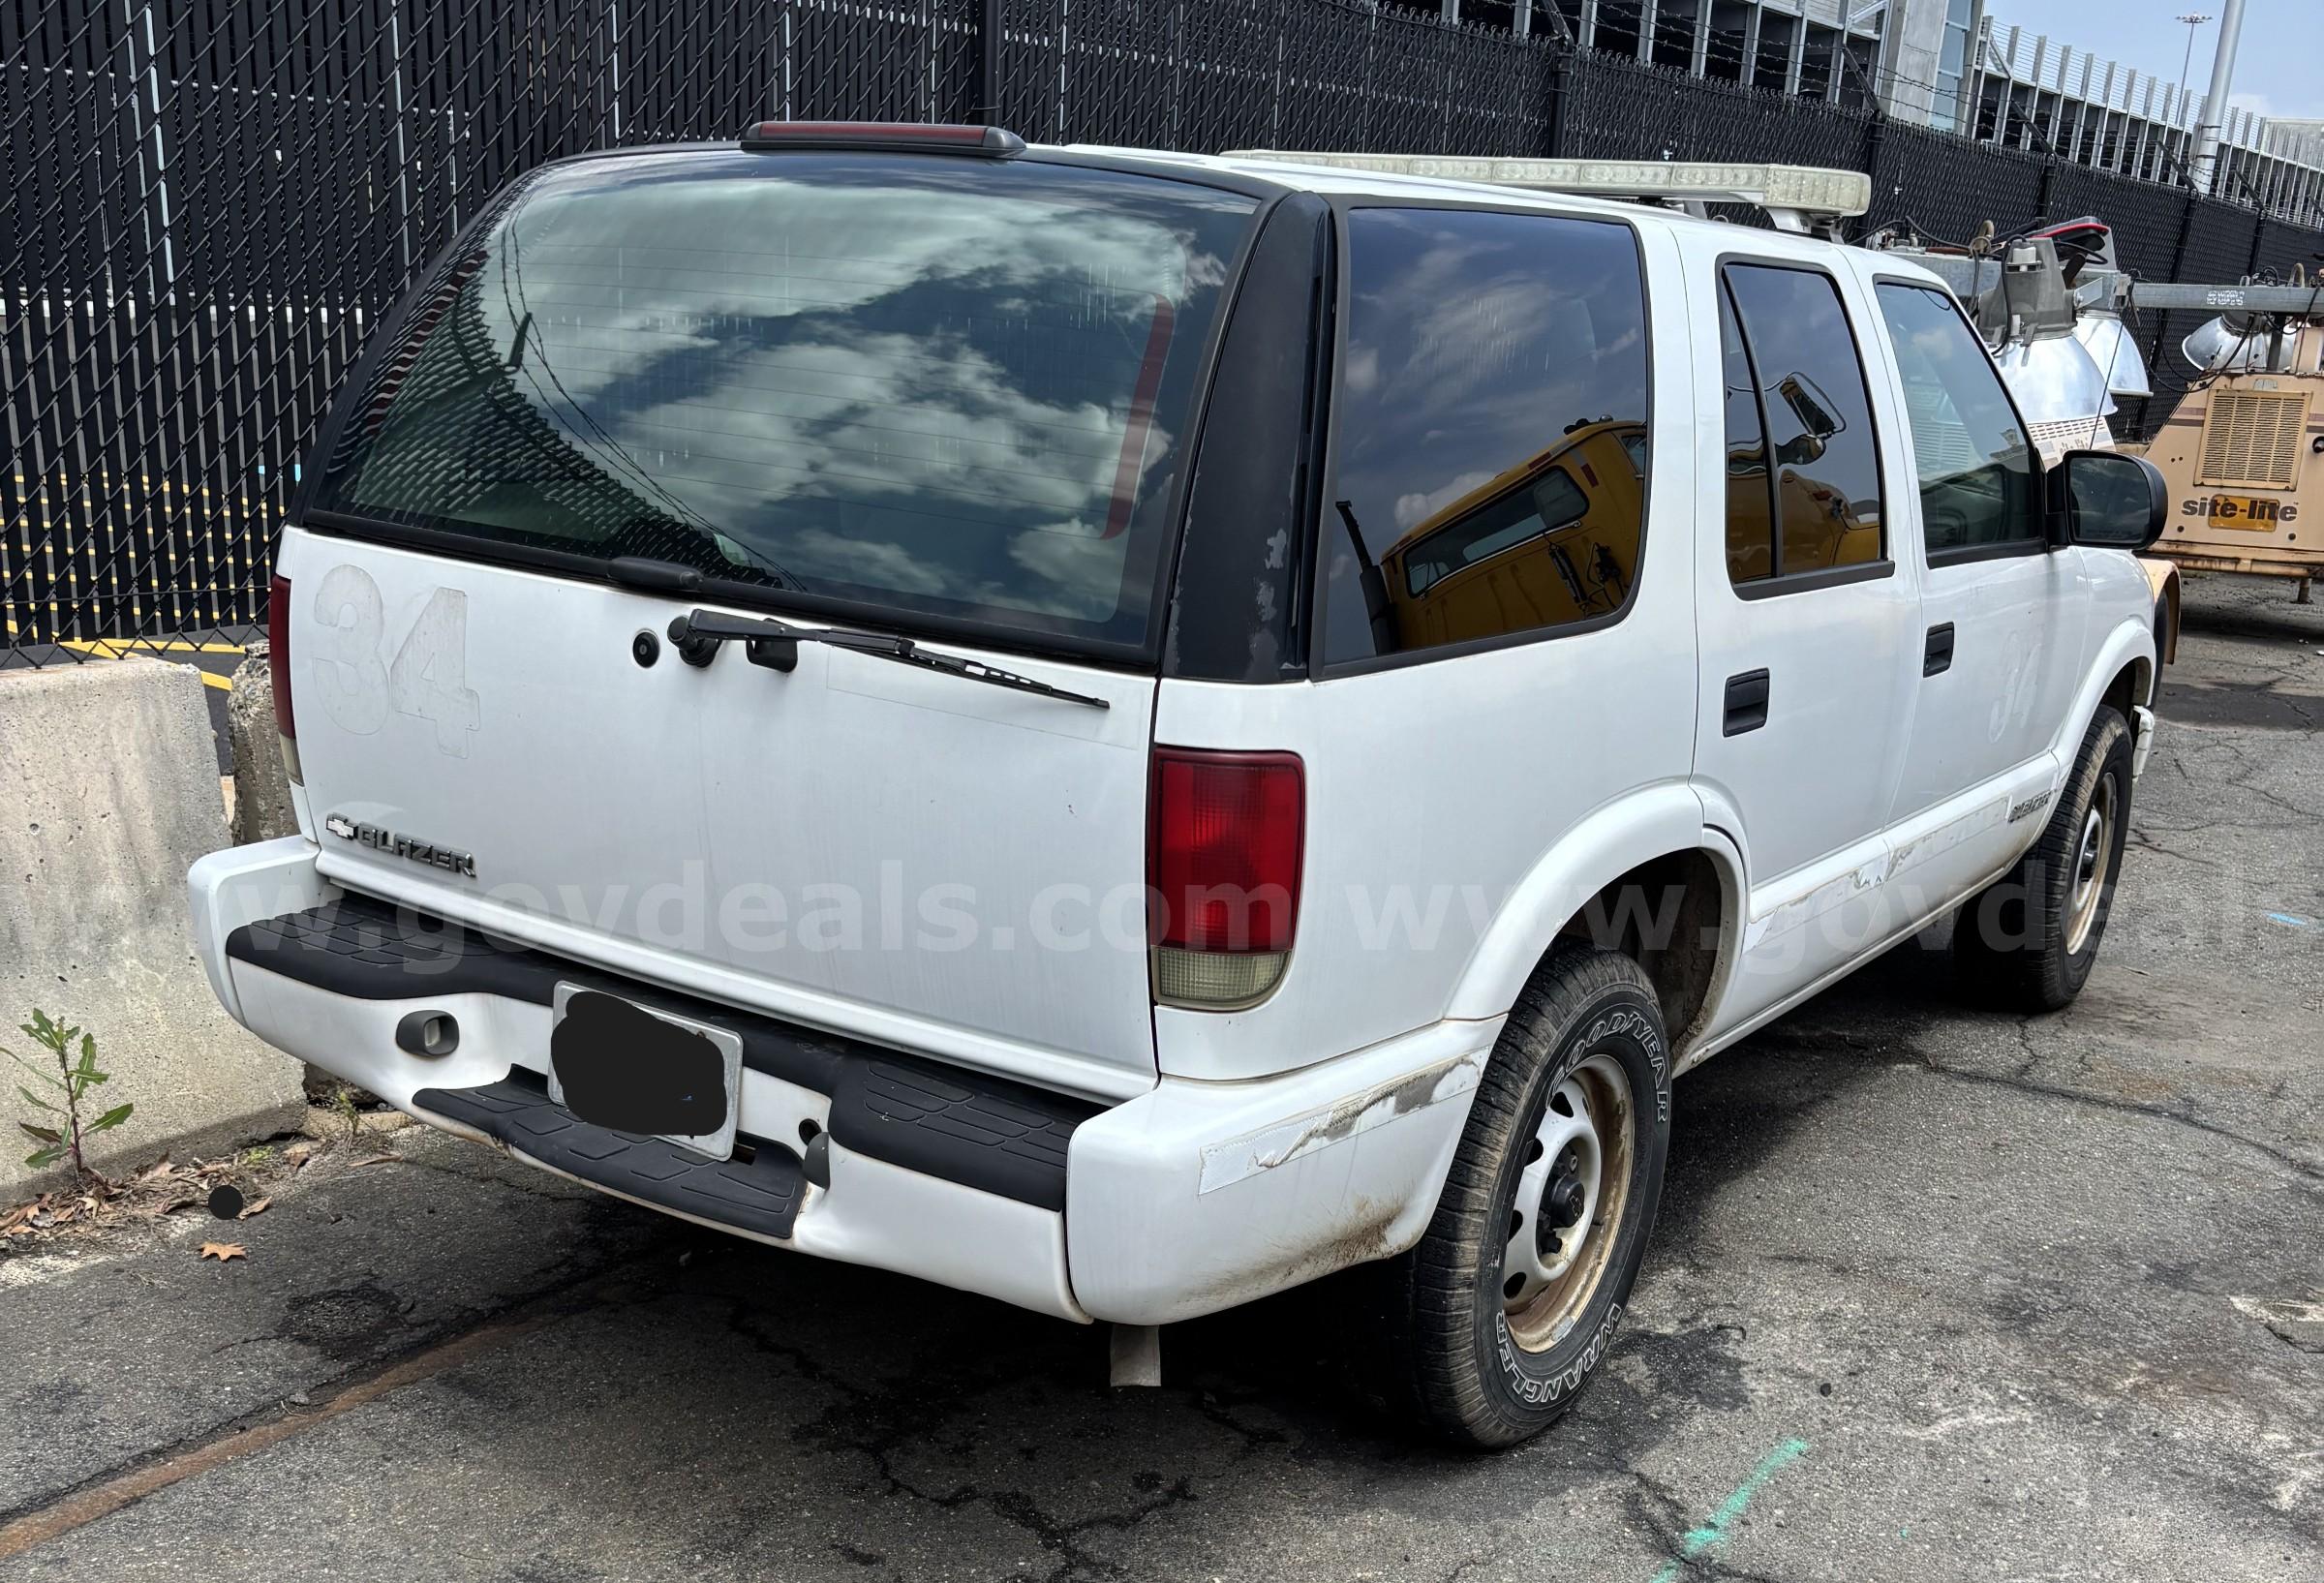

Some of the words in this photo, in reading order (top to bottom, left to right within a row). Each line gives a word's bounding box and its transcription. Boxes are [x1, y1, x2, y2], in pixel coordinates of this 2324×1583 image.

[2182, 497, 2298, 522] site-lite
[312, 564, 480, 759] 34
[356, 821, 477, 878] BLAZER
[1545, 1011, 1667, 1123] GOODYEAR
[1496, 1303, 1622, 1403] WRANGLER
